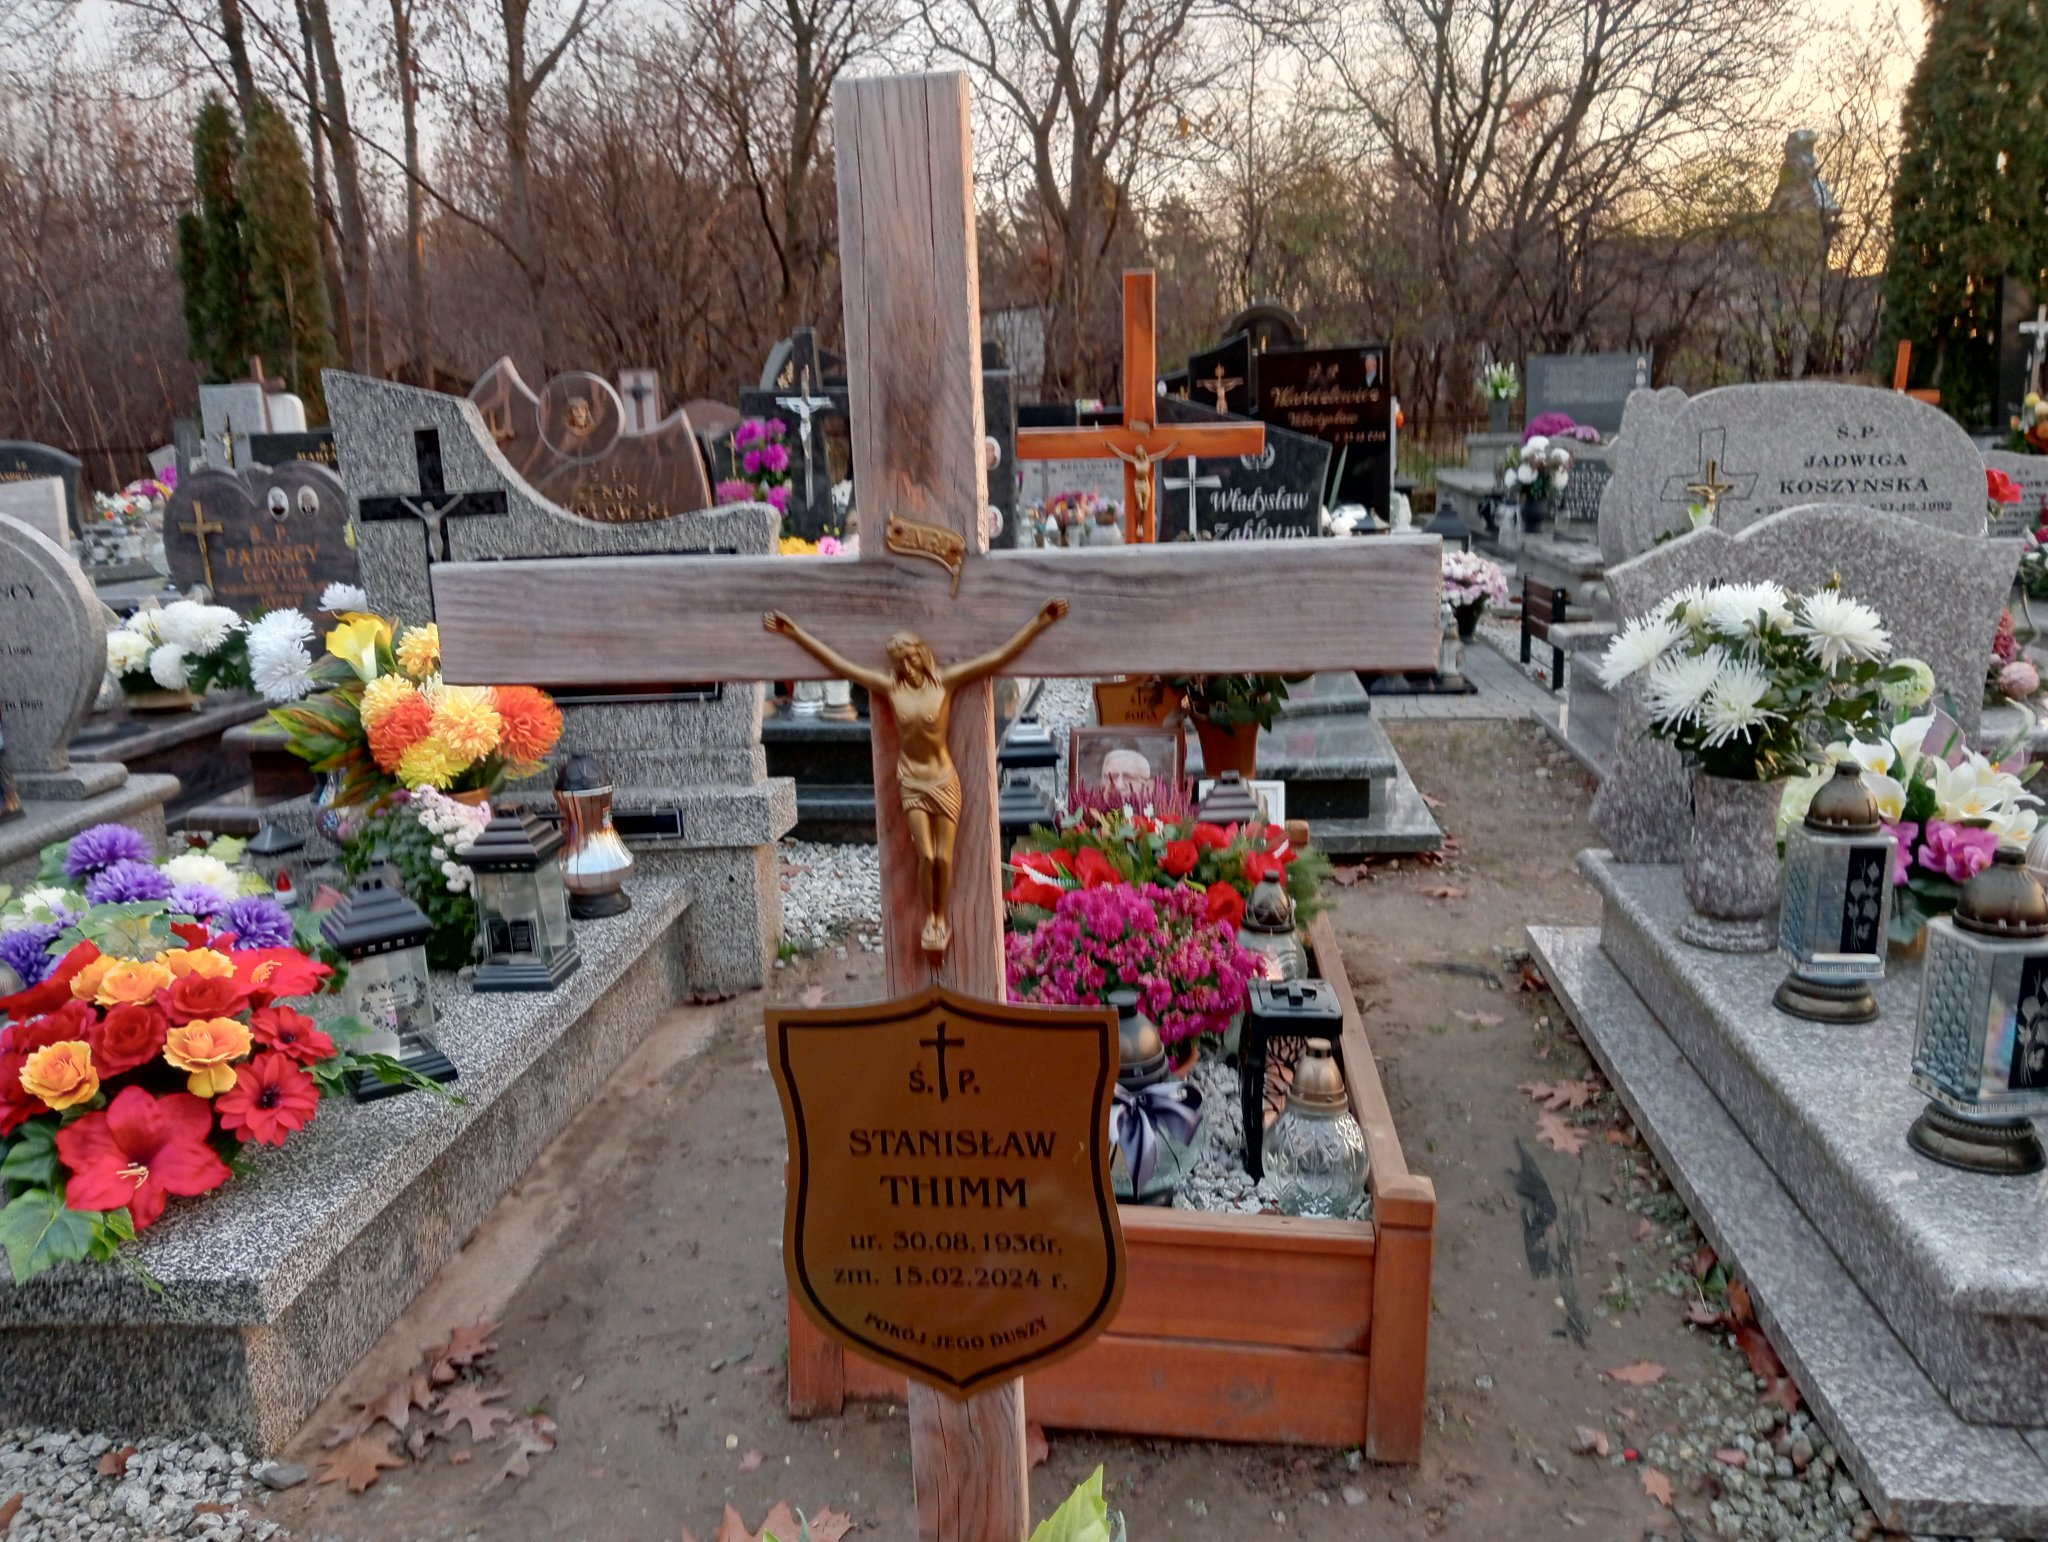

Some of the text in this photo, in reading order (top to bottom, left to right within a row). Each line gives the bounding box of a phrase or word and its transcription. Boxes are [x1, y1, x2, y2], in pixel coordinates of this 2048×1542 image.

[1804, 453, 1908, 468] JADWIGA
[1210, 485, 1309, 518] Władysław
[958, 1068, 981, 1094] P.
[849, 1129, 1056, 1159] STANISŁAW
[879, 1174, 1028, 1208] THIMM
[850, 1233, 883, 1251] ur.
[833, 1265, 1068, 1291] zm. 15.02.2024 r.
[864, 1312, 1048, 1349] POKÓJ JEGO DUSZY
